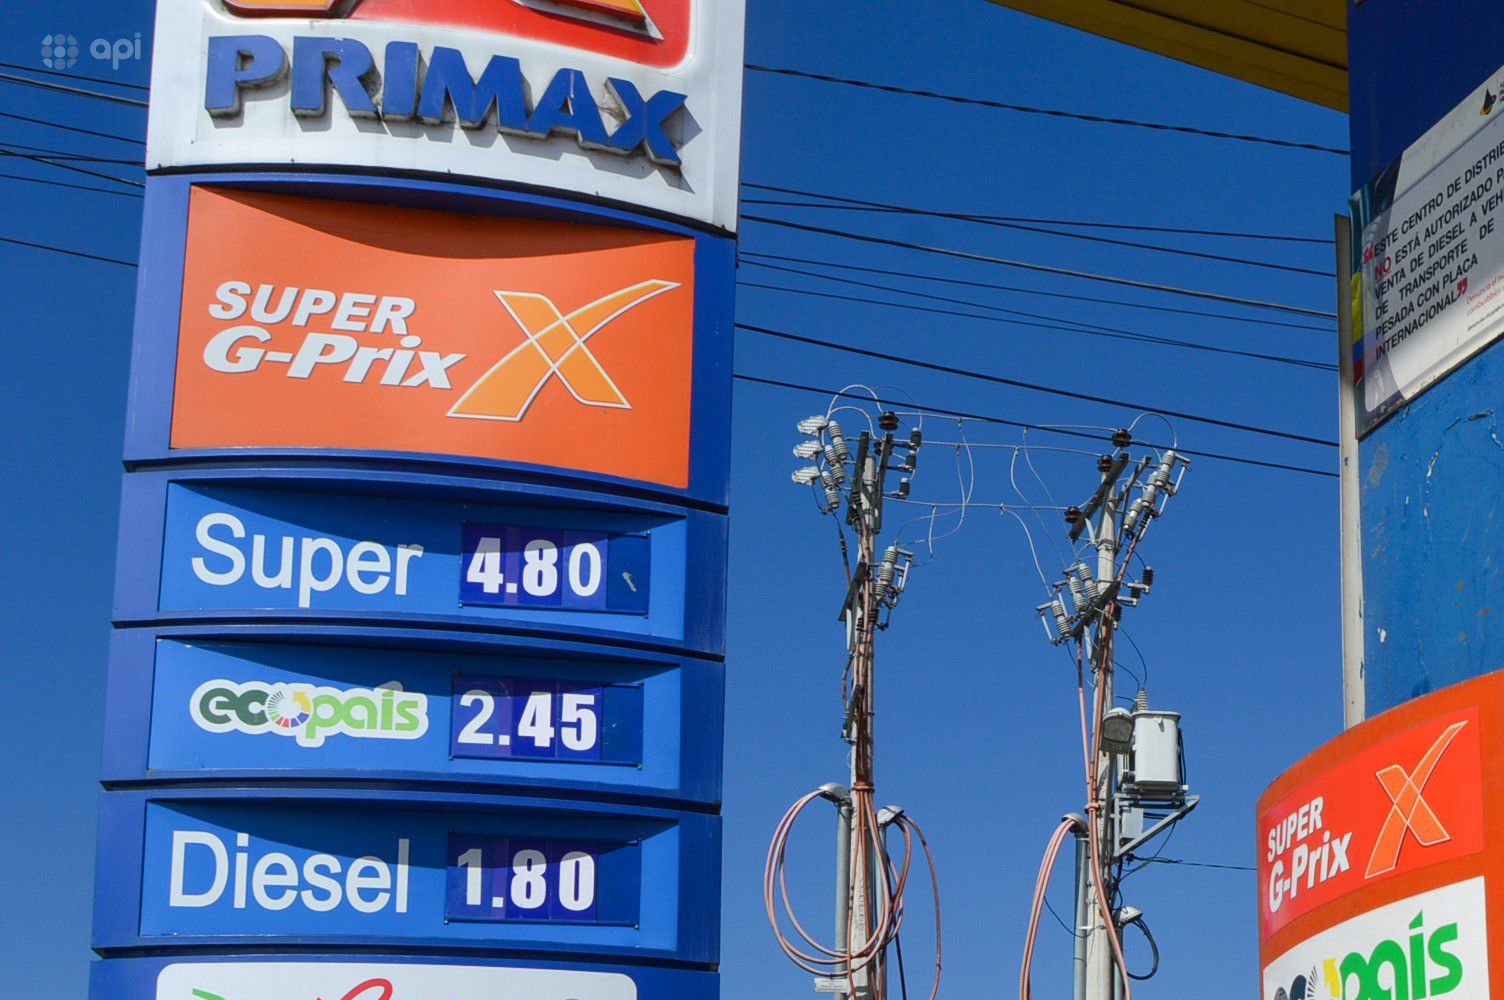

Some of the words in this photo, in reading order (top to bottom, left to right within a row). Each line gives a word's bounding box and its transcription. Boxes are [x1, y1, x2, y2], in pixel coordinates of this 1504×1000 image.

[204, 34, 690, 167] PRIMAX
[1375, 256, 1392, 280] NO
[1395, 232, 1420, 265] ESTÁ
[1424, 178, 1493, 242] AUTORIZADO
[1401, 192, 1443, 235] CENTRO
[1447, 178, 1461, 198] DE
[1375, 268, 1406, 299] VENTA
[1410, 252, 1424, 273] DE
[1429, 222, 1465, 258] DIESEL
[1469, 211, 1477, 227] A
[1375, 300, 1389, 320] DE
[1399, 239, 1468, 301] TRANSPORTE
[1479, 218, 1495, 240] DE
[1375, 306, 1415, 340] PESADA
[1417, 284, 1440, 308] CON
[1443, 253, 1478, 289] PLACA
[208, 280, 416, 335] SUPER
[203, 325, 467, 390] G-Prix
[191, 512, 424, 607] Super
[466, 537, 602, 597] 4.80
[457, 689, 598, 751] 2.45
[169, 829, 410, 914] Diesel
[456, 848, 595, 910] 1.80
[1268, 796, 1324, 863] SUPER
[1269, 831, 1353, 913] G-Prix
